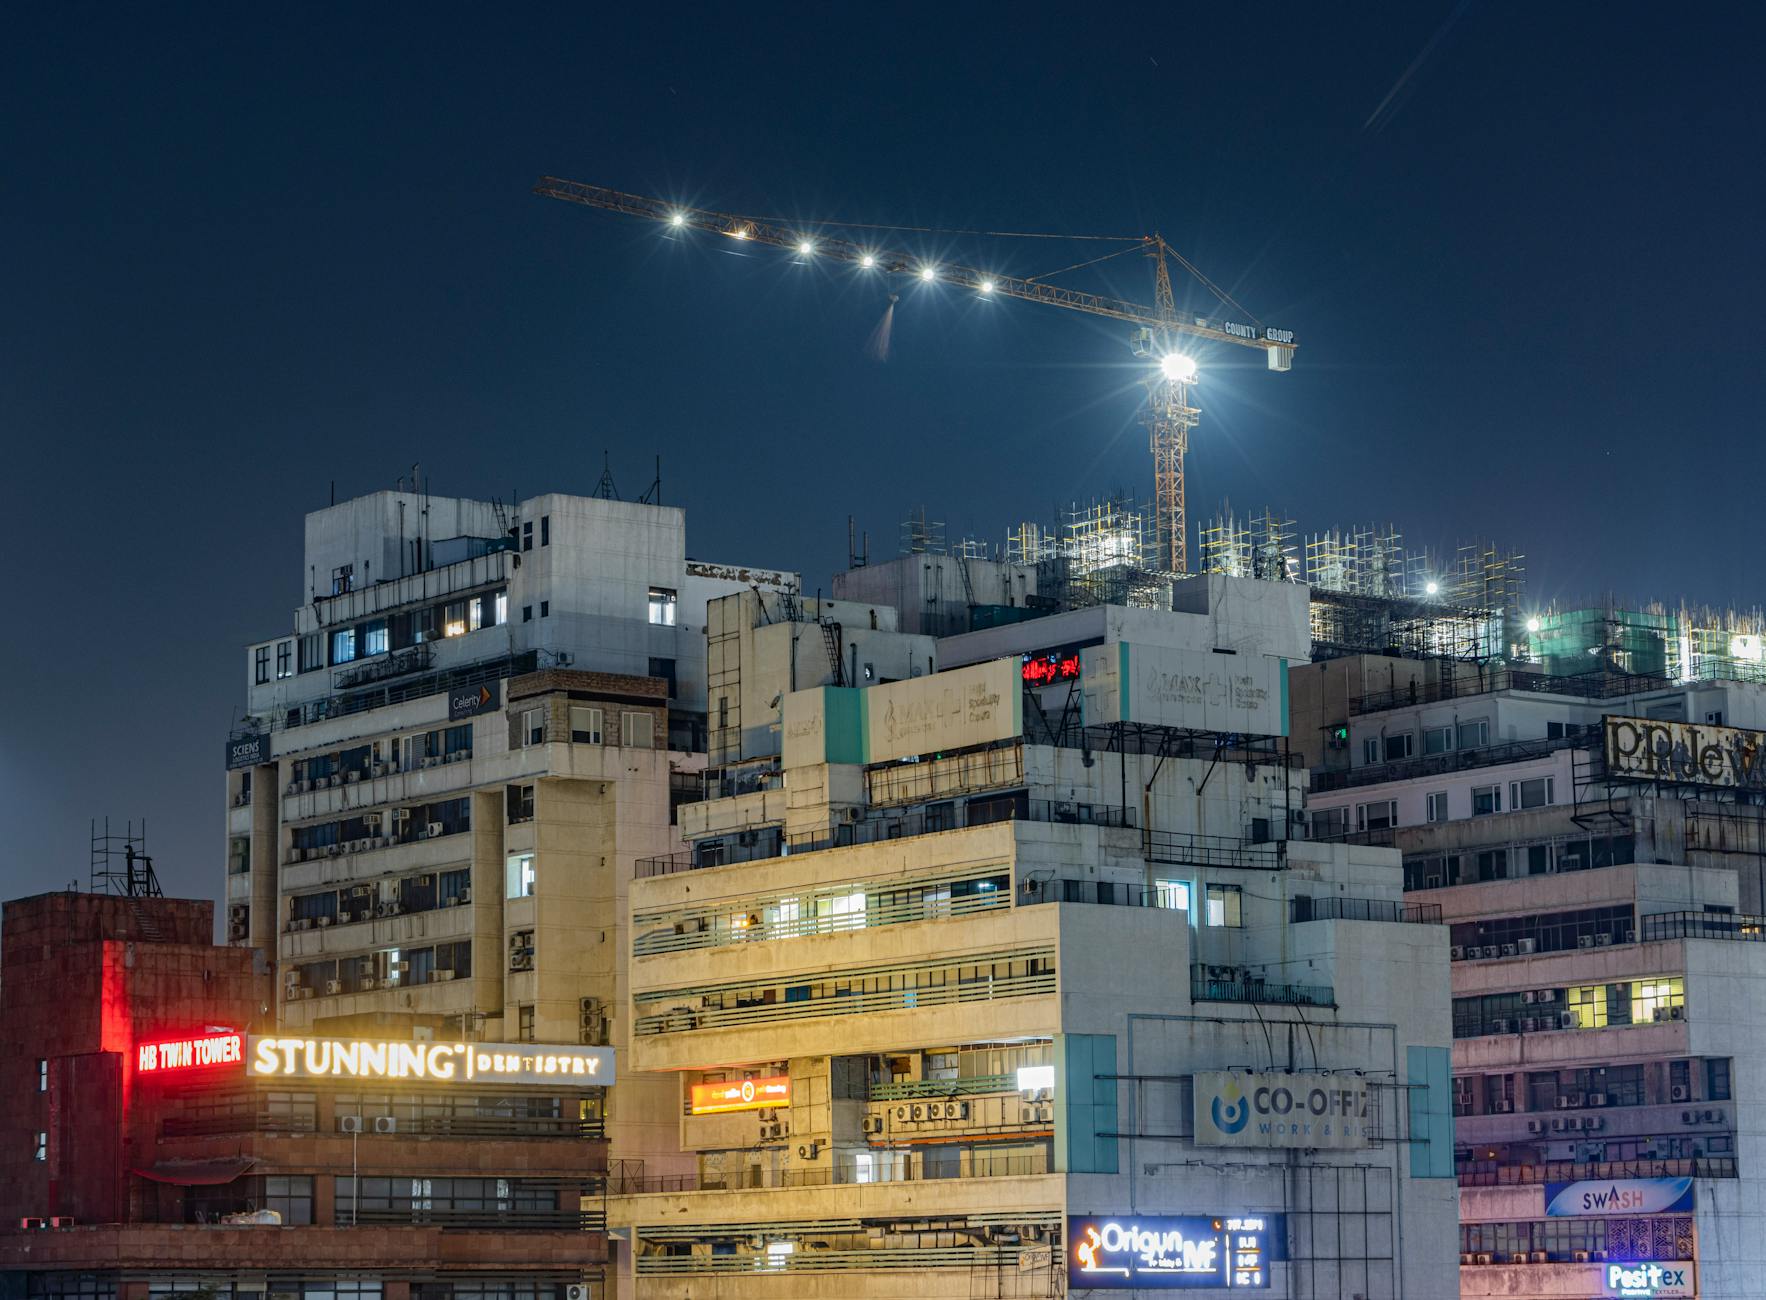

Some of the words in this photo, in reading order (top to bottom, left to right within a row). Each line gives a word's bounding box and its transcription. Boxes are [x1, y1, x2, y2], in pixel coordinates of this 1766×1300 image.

[1225, 321, 1256, 339] COUNTY
[1266, 327, 1294, 343] GROUP
[453, 694, 481, 709] Celerity
[232, 738, 260, 757] SCIENS
[1679, 726, 1766, 785] Jew
[139, 1045, 157, 1071] HB
[159, 1040, 193, 1069] TWIN
[194, 1036, 241, 1065] TOWER
[254, 1038, 455, 1079] STUNNING
[477, 1054, 600, 1075] DENTISTRY
[1259, 1123, 1311, 1135] WORK
[1324, 1124, 1332, 1136] &
[1583, 1184, 1644, 1211] SWASH
[1101, 1222, 1183, 1260] Origyn
